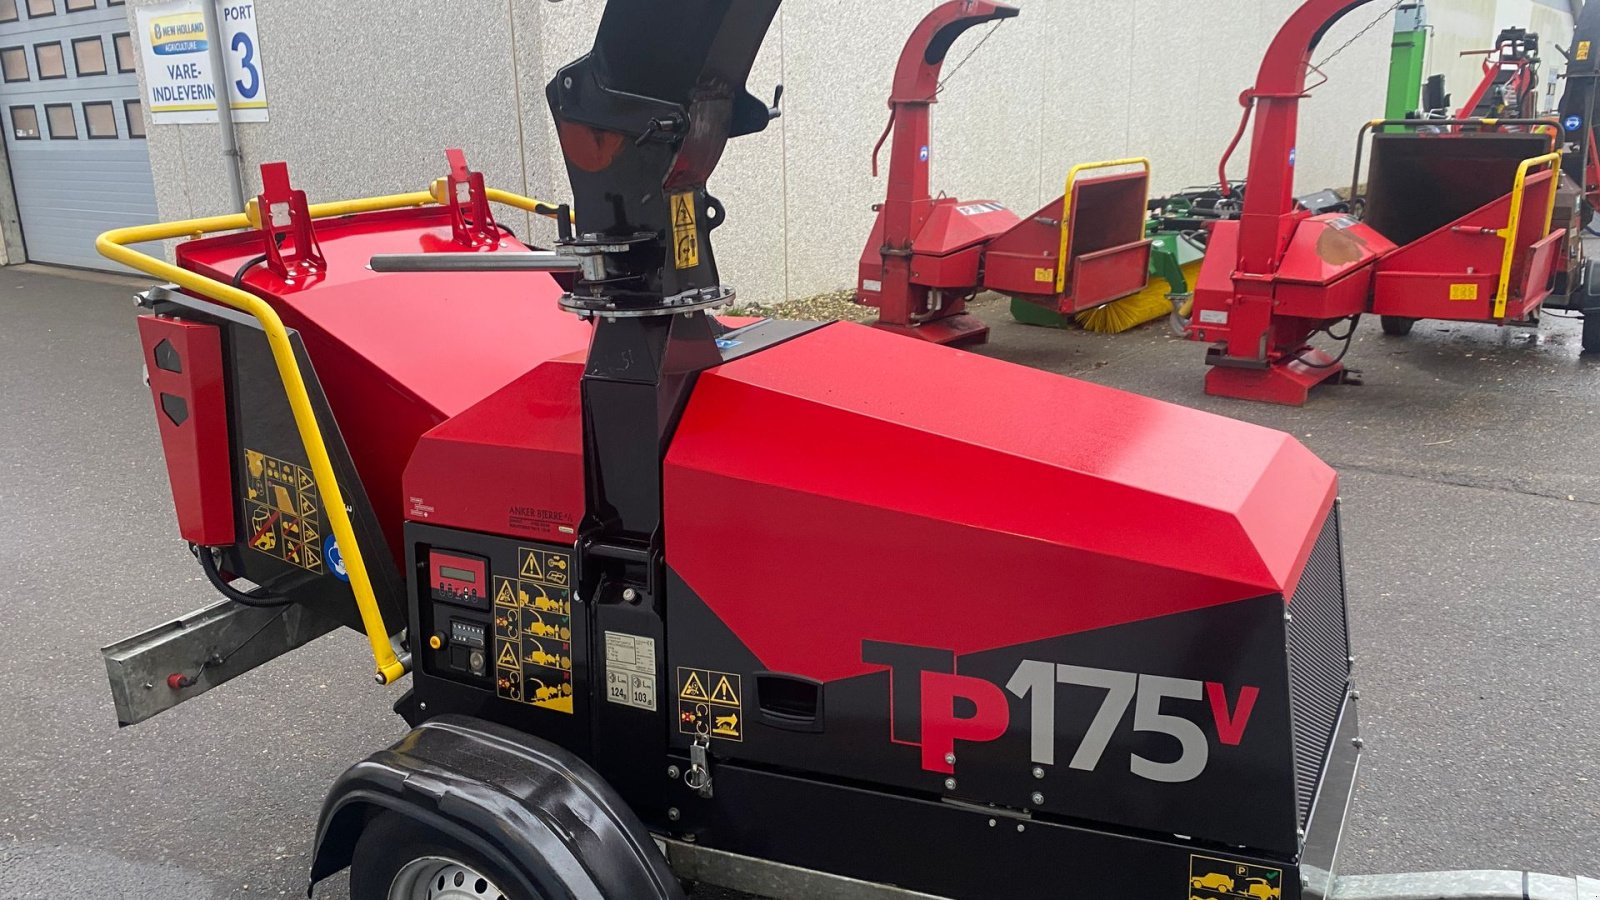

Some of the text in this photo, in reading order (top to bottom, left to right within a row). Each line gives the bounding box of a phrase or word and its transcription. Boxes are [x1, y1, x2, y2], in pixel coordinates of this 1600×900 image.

[224, 5, 252, 21] PORT
[162, 22, 204, 36] NEW HOLLAND
[165, 41, 197, 52] AGRICULTURE
[167, 63, 201, 80] VARE-
[231, 31, 259, 99] 3
[152, 84, 216, 102] INDLEVERIN
[509, 506, 535, 517] ANKER
[536, 508, 563, 521] BJERRE
[611, 686, 624, 698] 124
[634, 691, 647, 703] 103
[861, 638, 1010, 775] TP
[1005, 659, 1209, 784] 175
